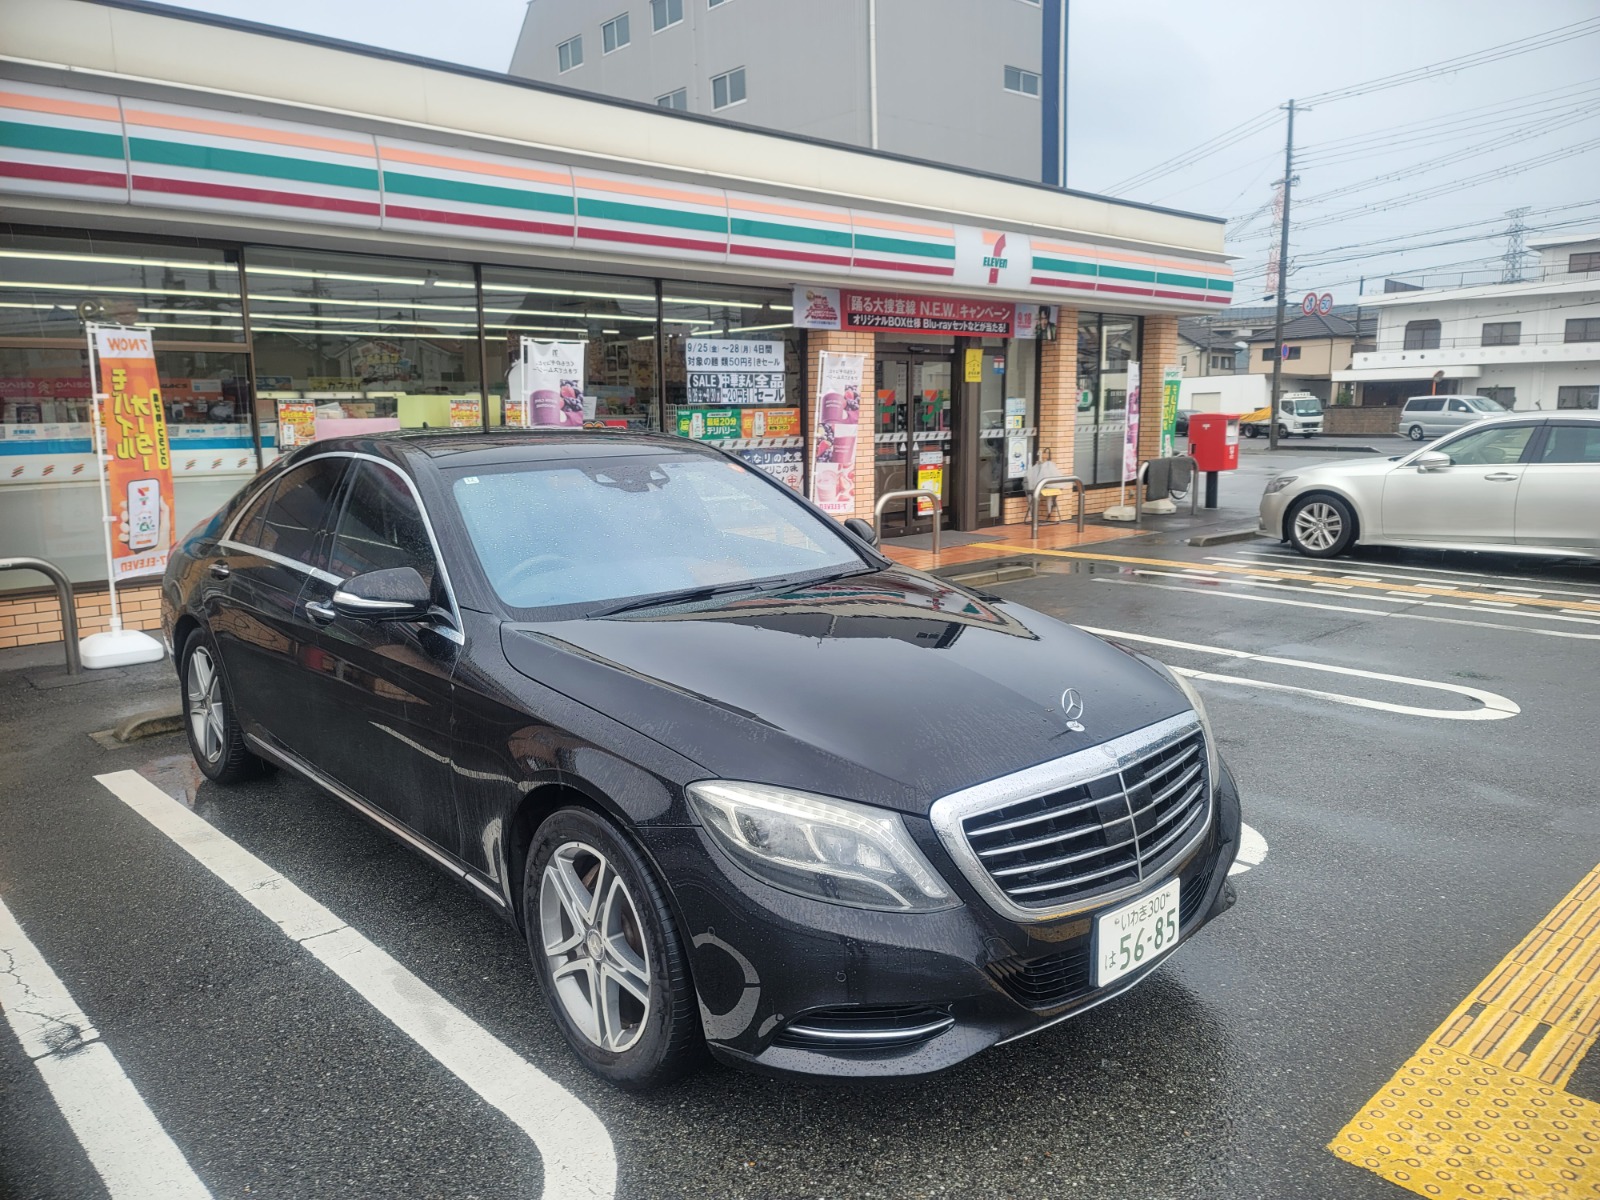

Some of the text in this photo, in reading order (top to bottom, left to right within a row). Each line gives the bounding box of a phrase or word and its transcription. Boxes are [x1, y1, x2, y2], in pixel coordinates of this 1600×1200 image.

[755, 373, 785, 388] 全品
[755, 388, 784, 402] セール
[1121, 893, 1166, 931] いわき 300
[1104, 907, 1176, 971] は 56-85
